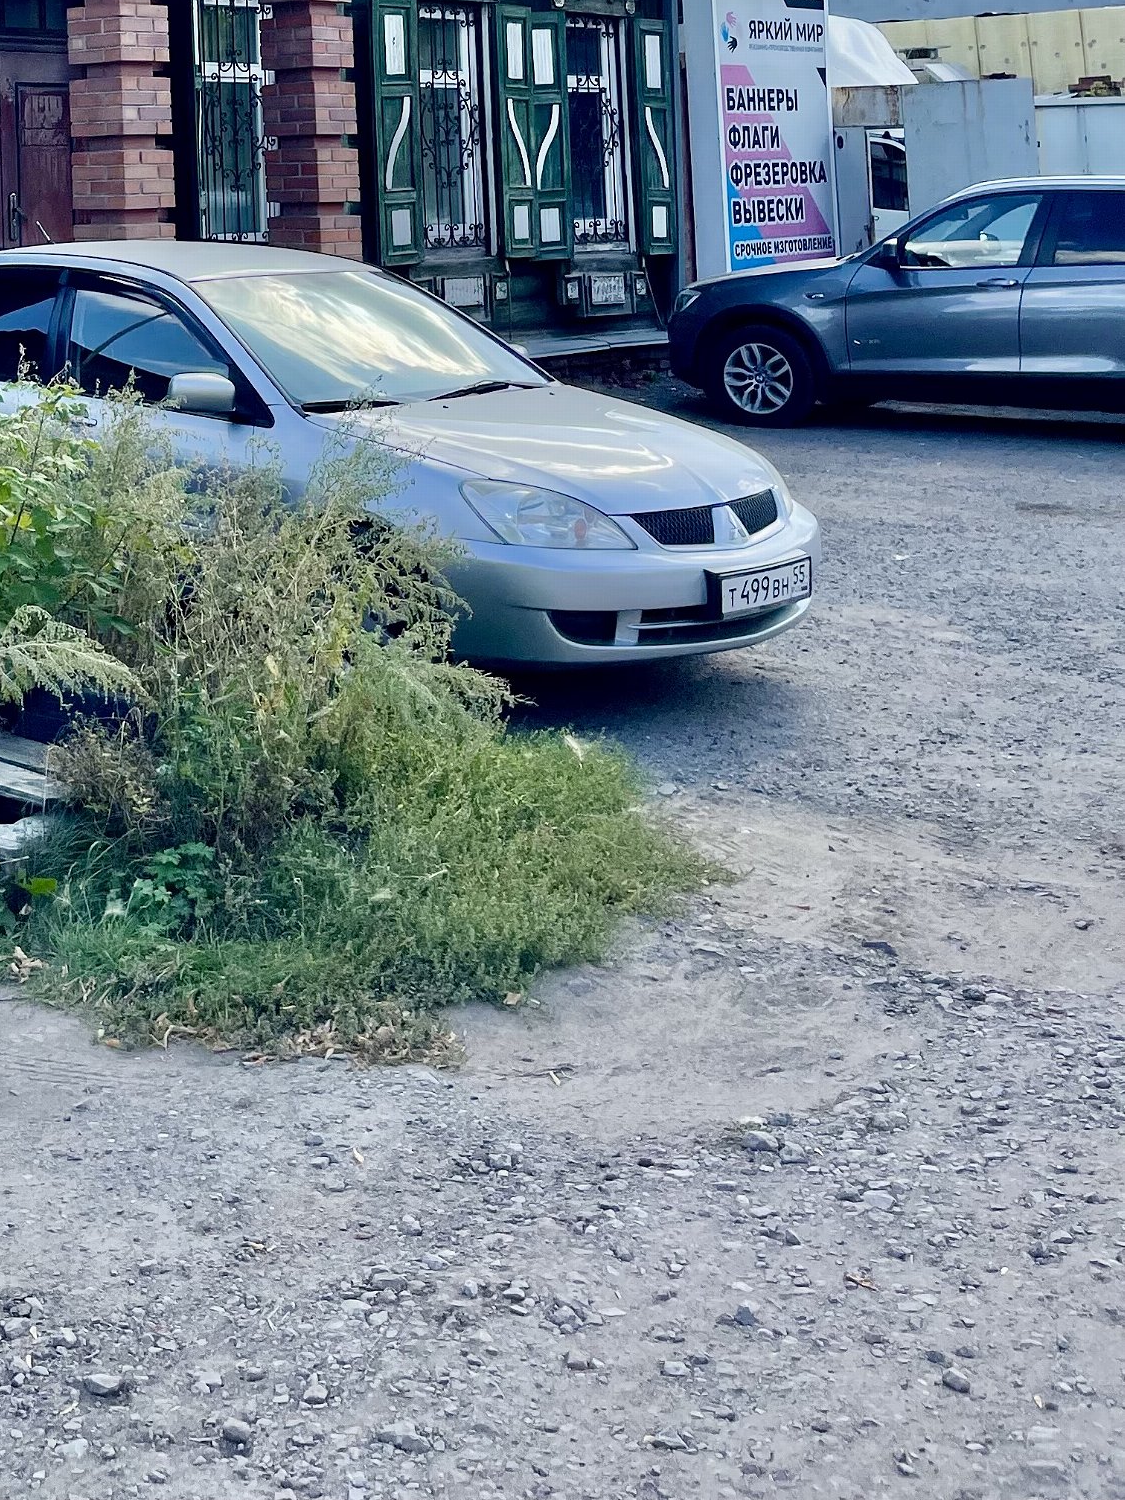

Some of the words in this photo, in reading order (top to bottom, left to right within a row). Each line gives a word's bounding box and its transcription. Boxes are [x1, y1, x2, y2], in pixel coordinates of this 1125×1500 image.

[749, 18, 793, 41] ЯРКИЙ
[796, 23, 823, 42] МИР
[726, 88, 798, 111] БАННЕРЫ
[729, 125, 780, 148] ФЛАГИ
[730, 161, 827, 186] ФРЕЗЕРОВКА
[733, 197, 804, 224] ВЫВЕСКИ
[735, 241, 773, 257] СРОЧНОЕ
[774, 235, 833, 254] ИЗГОТОВЛЕНИЕ
